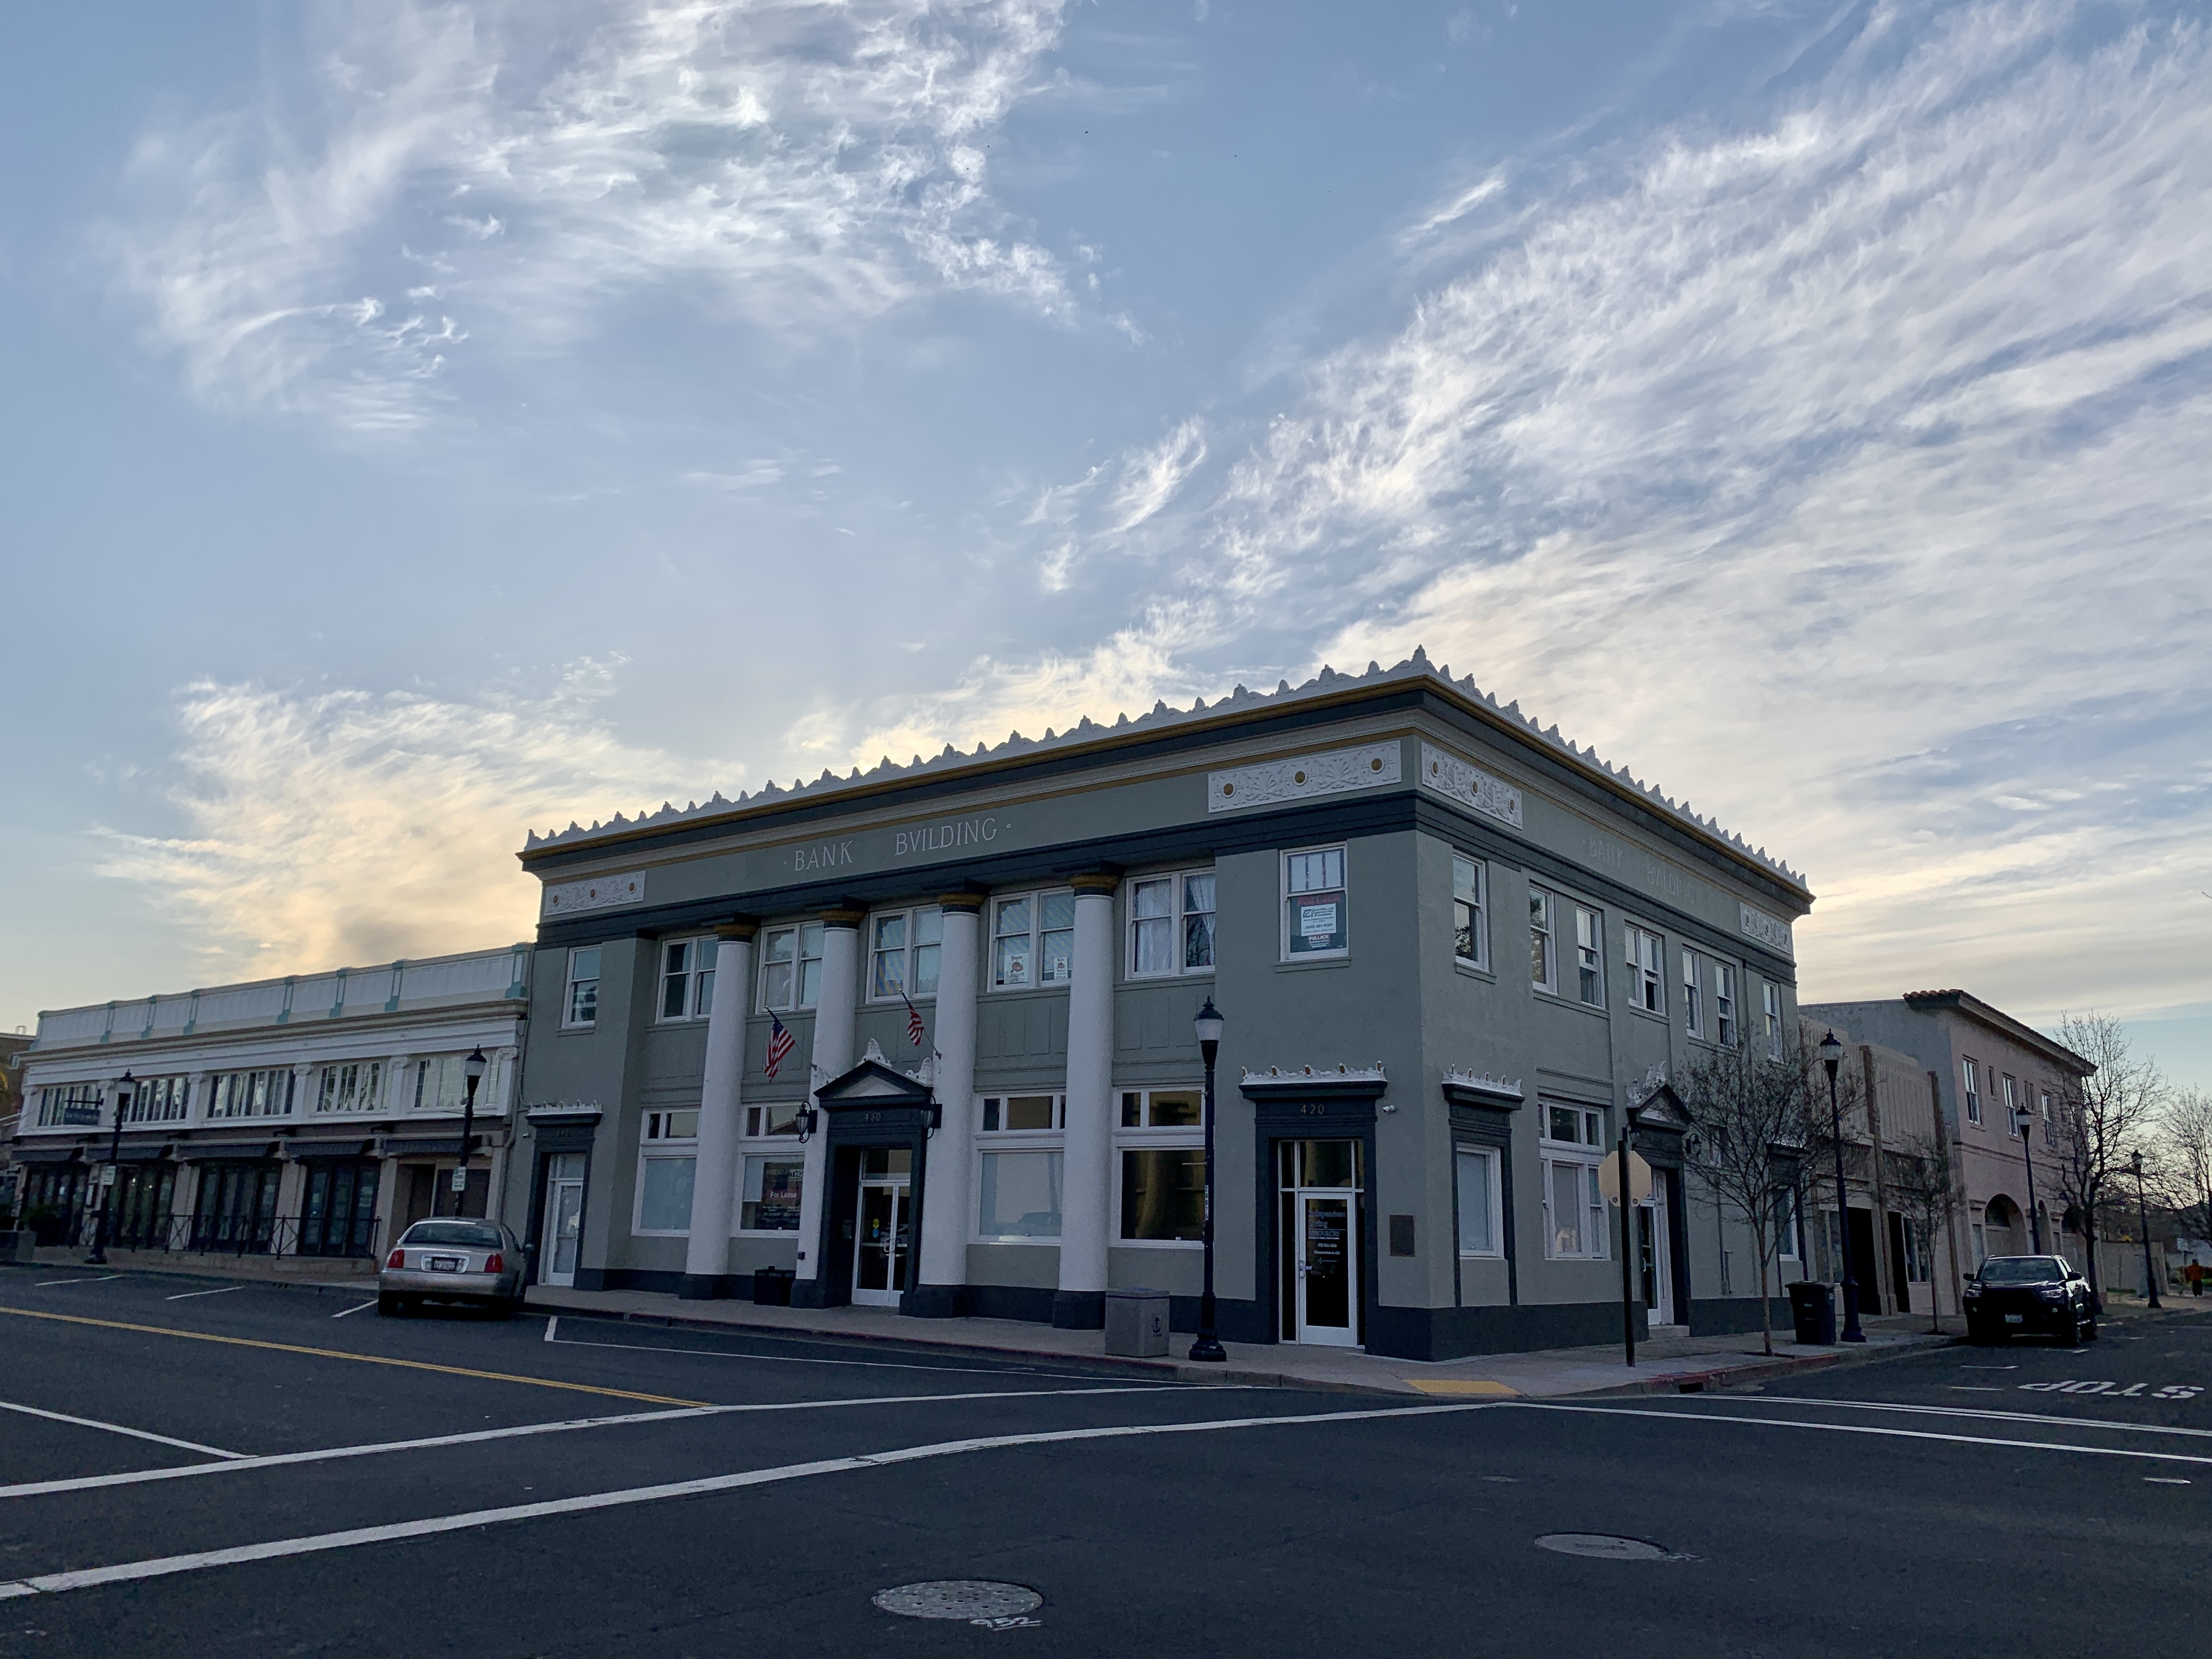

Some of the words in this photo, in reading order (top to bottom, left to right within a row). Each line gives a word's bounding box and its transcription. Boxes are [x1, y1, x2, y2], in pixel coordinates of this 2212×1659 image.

[794, 840, 854, 871] BANK
[894, 817, 997, 856] BVILDING
[864, 1112, 881, 1121] 430
[1301, 1104, 1325, 1115] 420
[2017, 1380, 2206, 1400] STOP
